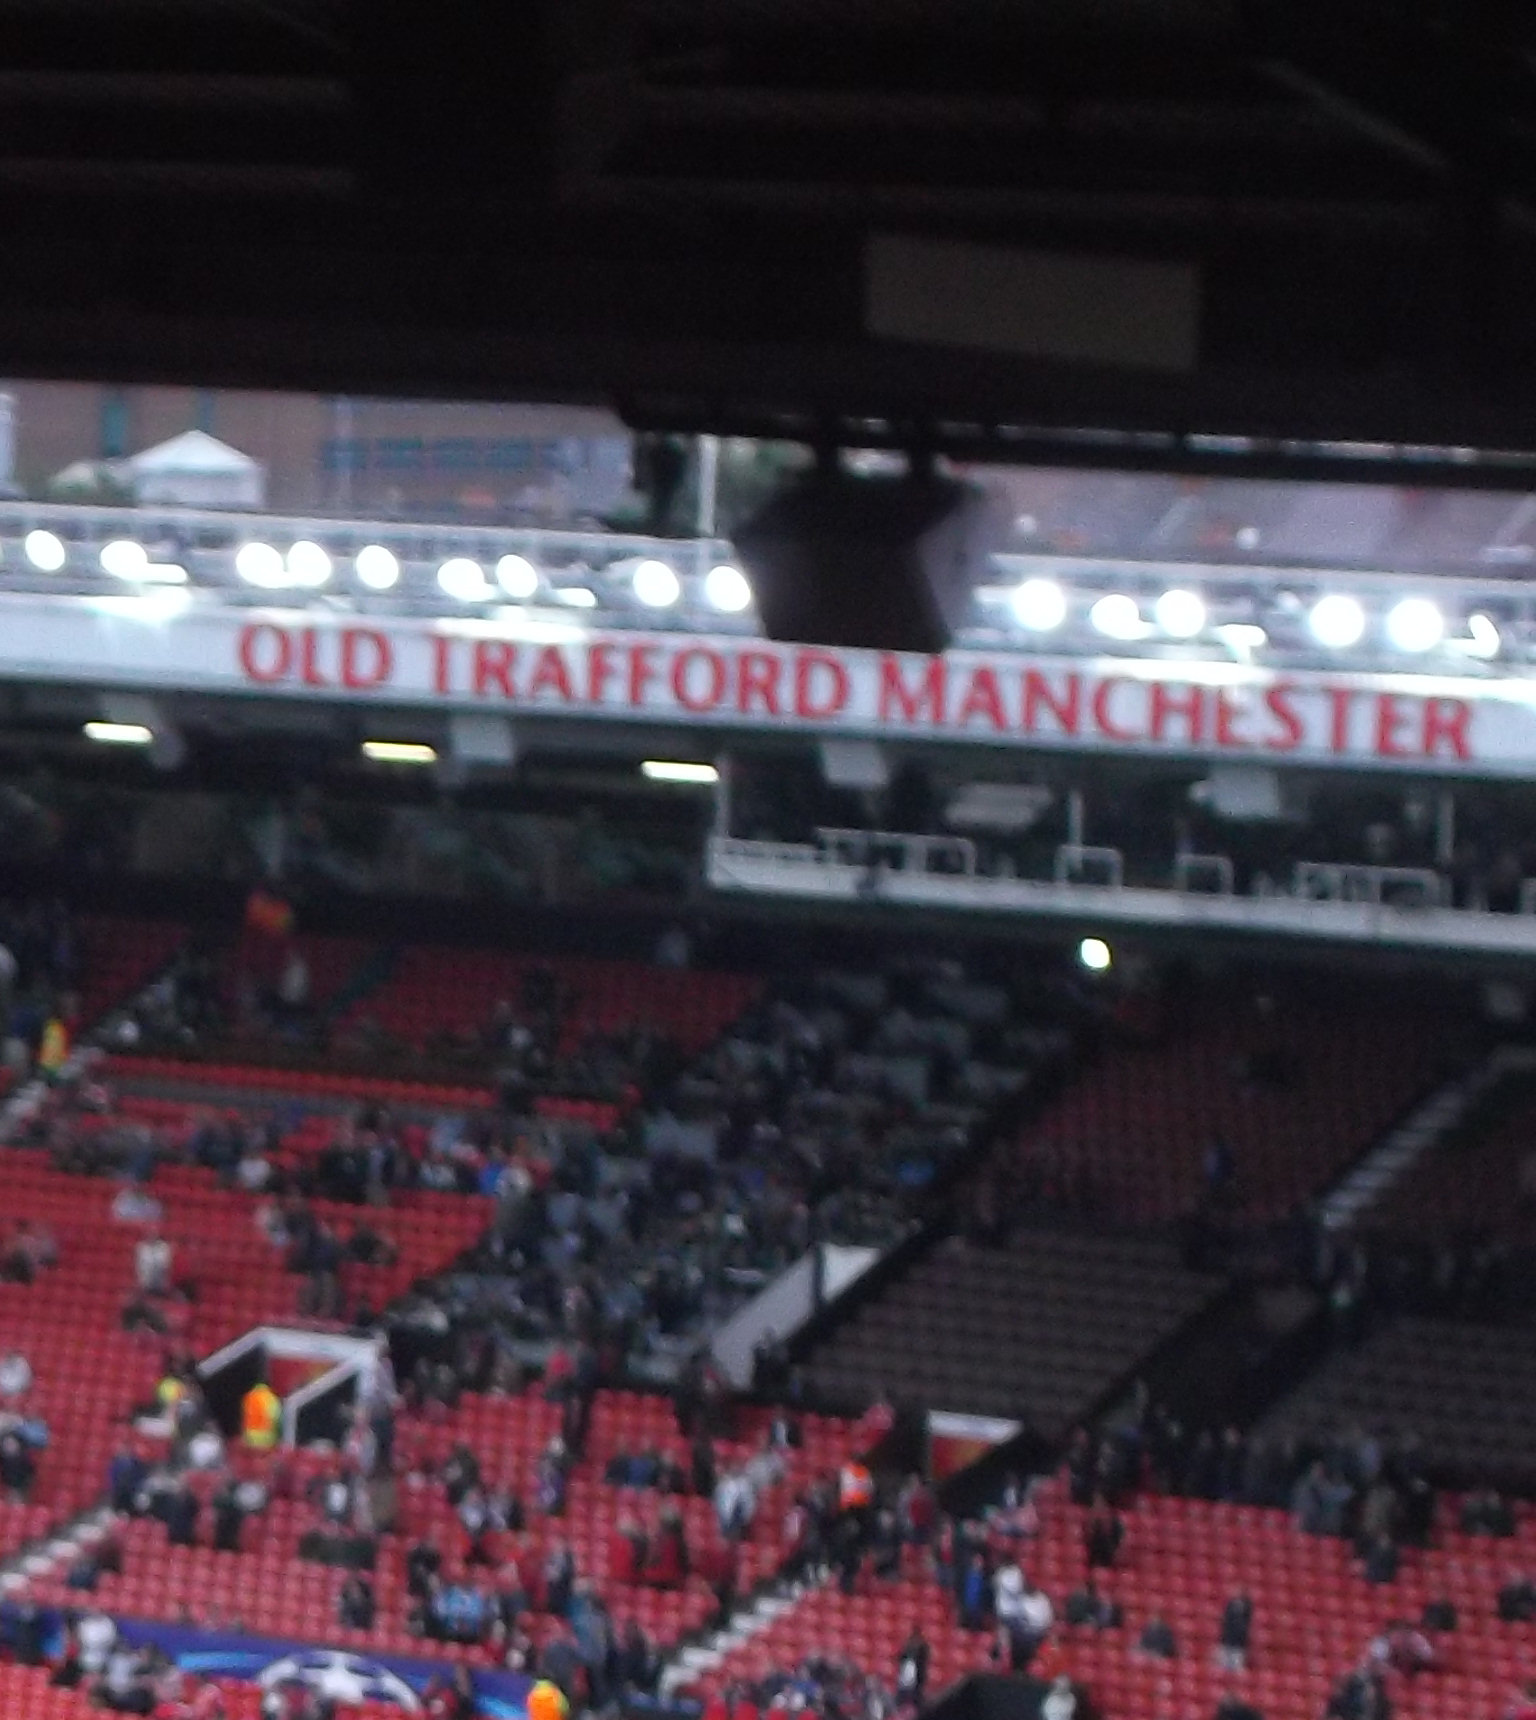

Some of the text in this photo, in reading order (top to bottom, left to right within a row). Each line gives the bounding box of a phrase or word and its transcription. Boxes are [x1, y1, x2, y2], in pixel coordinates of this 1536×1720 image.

[238, 620, 1474, 762] OLD TRAFFORD MANCHESTER
